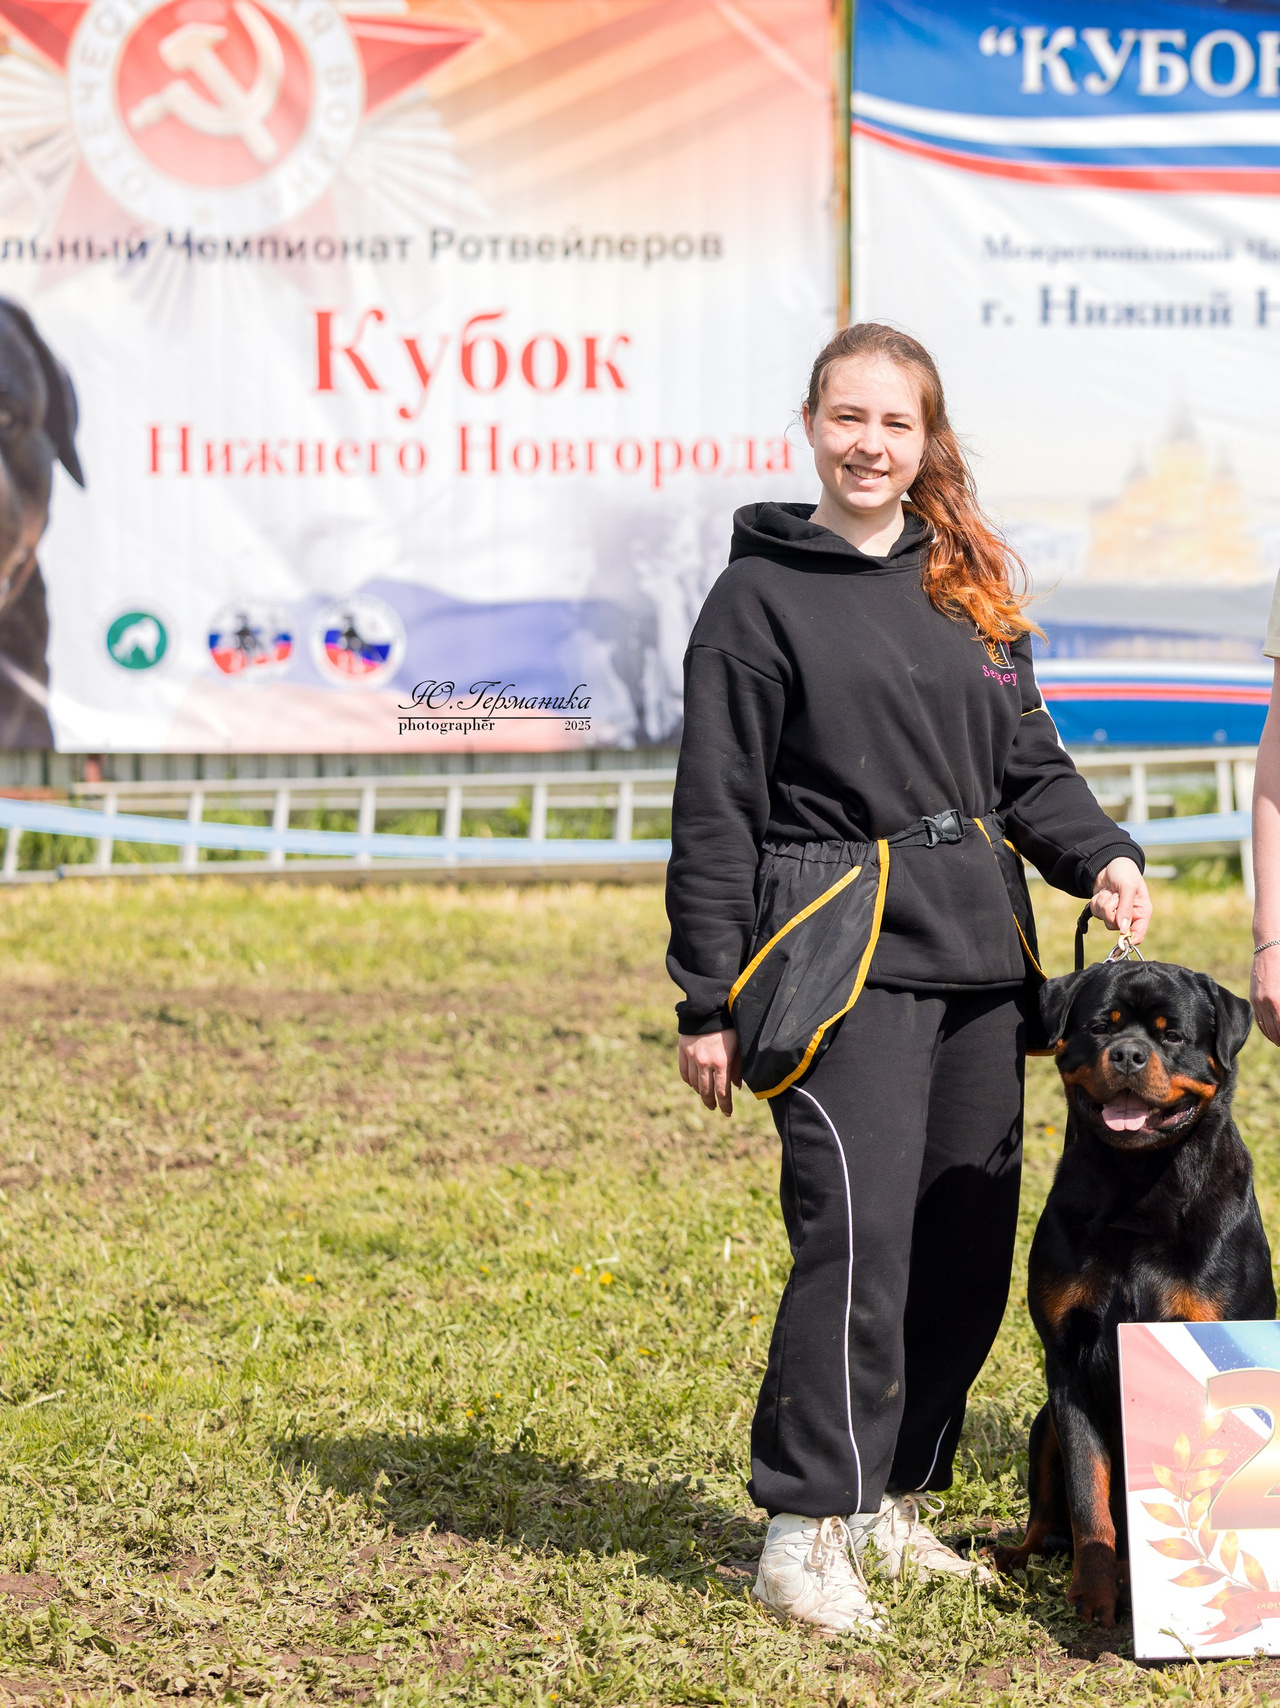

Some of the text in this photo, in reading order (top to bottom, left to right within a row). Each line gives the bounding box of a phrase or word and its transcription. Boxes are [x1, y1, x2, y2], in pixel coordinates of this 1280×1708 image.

[0, 230, 724, 267] льный Чемпионат Ротвейлеров
[1040, 286, 1234, 328] Нижний
[313, 308, 632, 420] Кубок
[148, 424, 794, 490] Нижнего Новгорода
